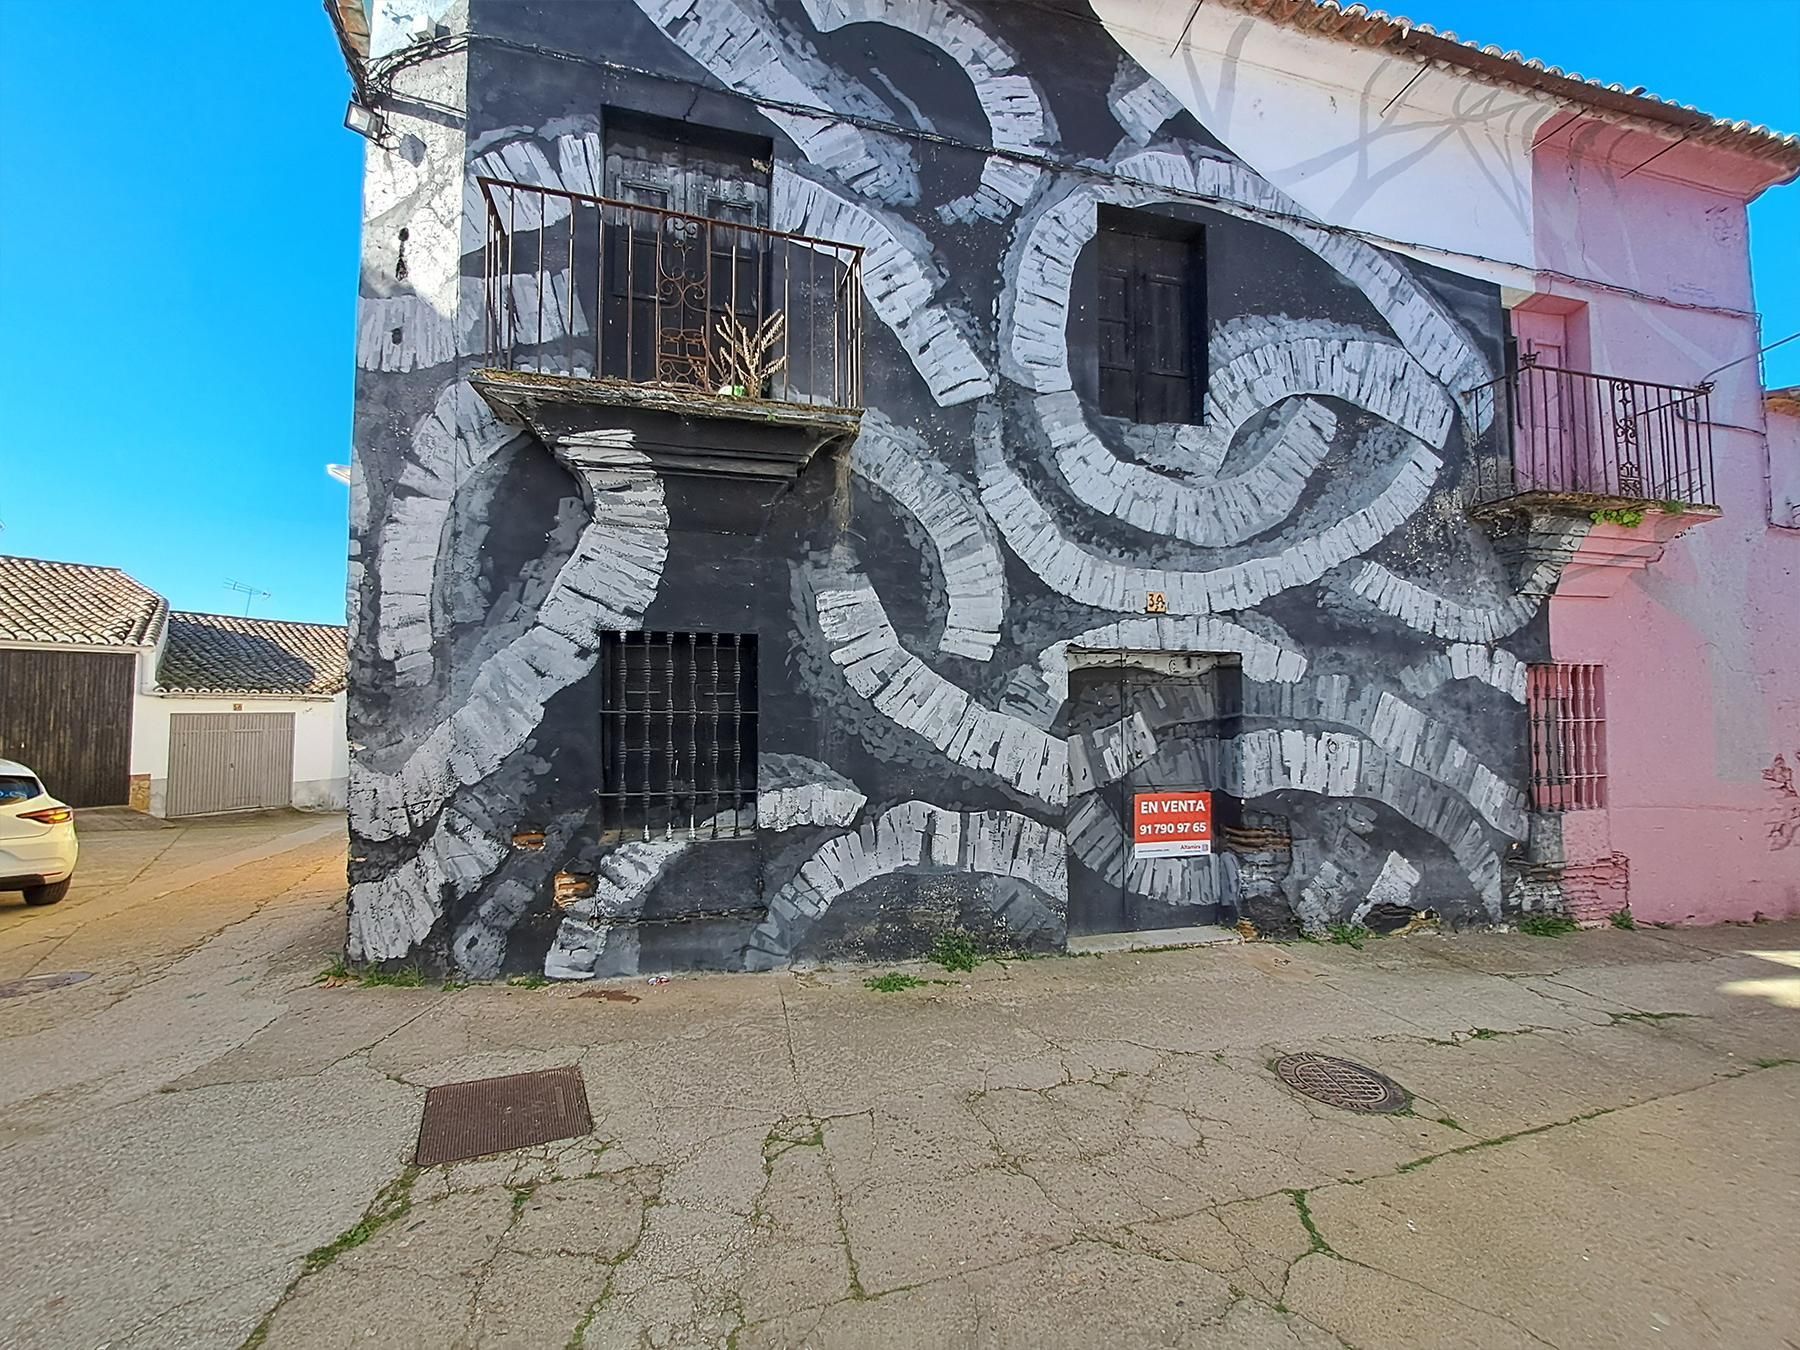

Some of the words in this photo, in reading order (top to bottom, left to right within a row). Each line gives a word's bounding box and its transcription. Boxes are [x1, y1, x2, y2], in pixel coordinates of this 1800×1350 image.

[1141, 801, 1158, 814] EN
[1161, 800, 1206, 813] VENTA
[1139, 824, 1152, 835] 91
[1154, 823, 1175, 834] 790
[1177, 822, 1191, 833] 97
[1193, 822, 1207, 832] 65
